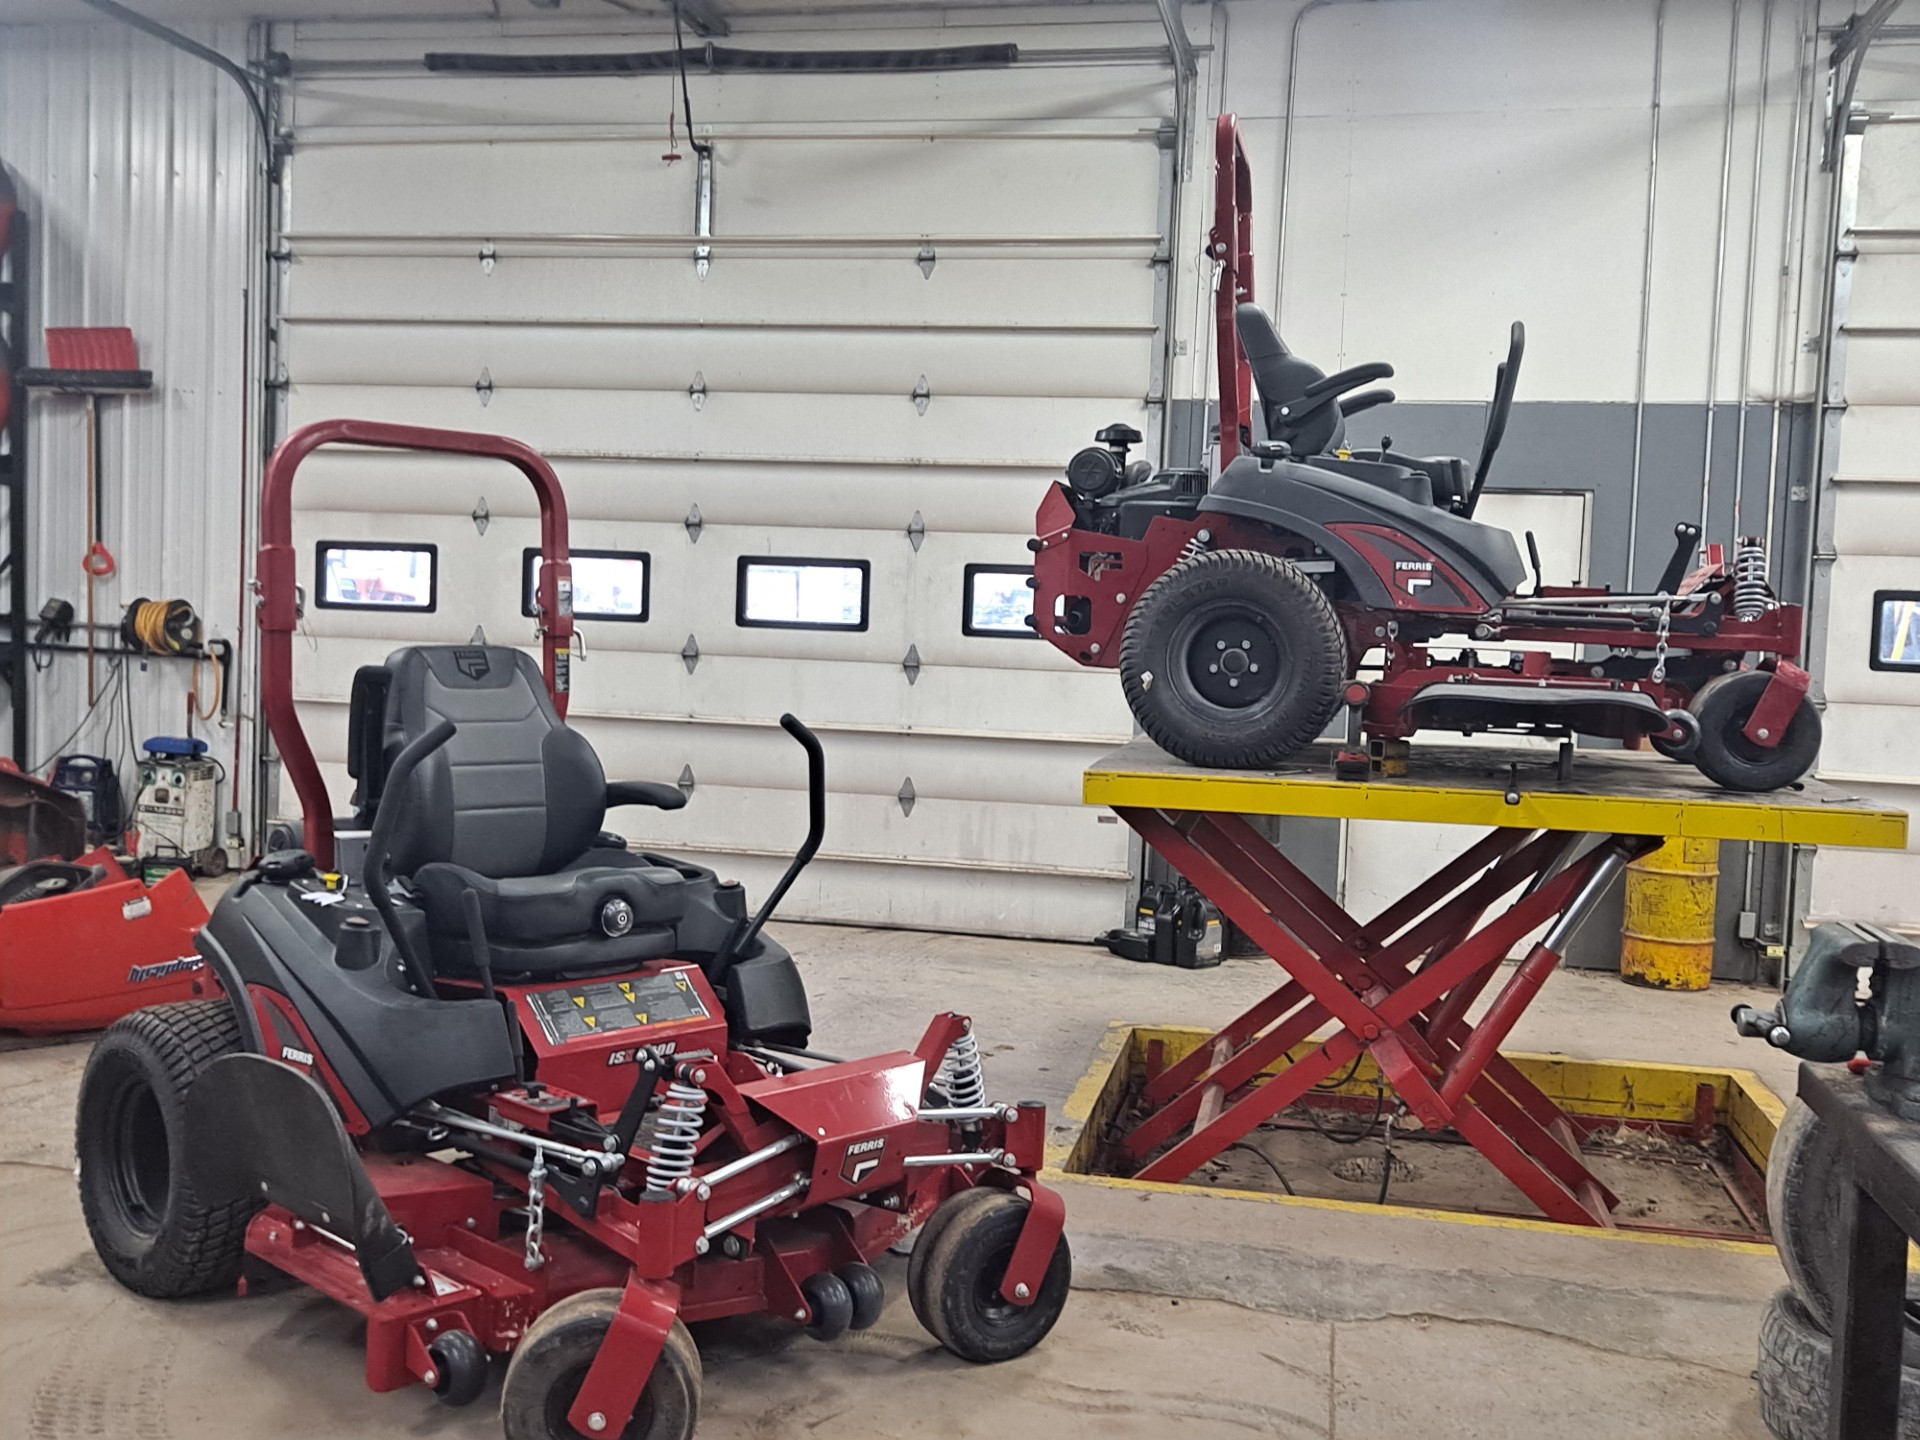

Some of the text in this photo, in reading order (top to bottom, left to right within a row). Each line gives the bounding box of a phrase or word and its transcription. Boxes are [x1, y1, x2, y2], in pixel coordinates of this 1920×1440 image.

[1395, 561, 1432, 571] FERRIS
[282, 1046, 314, 1066] FERRIS
[847, 1137, 885, 1156] FERRIS
